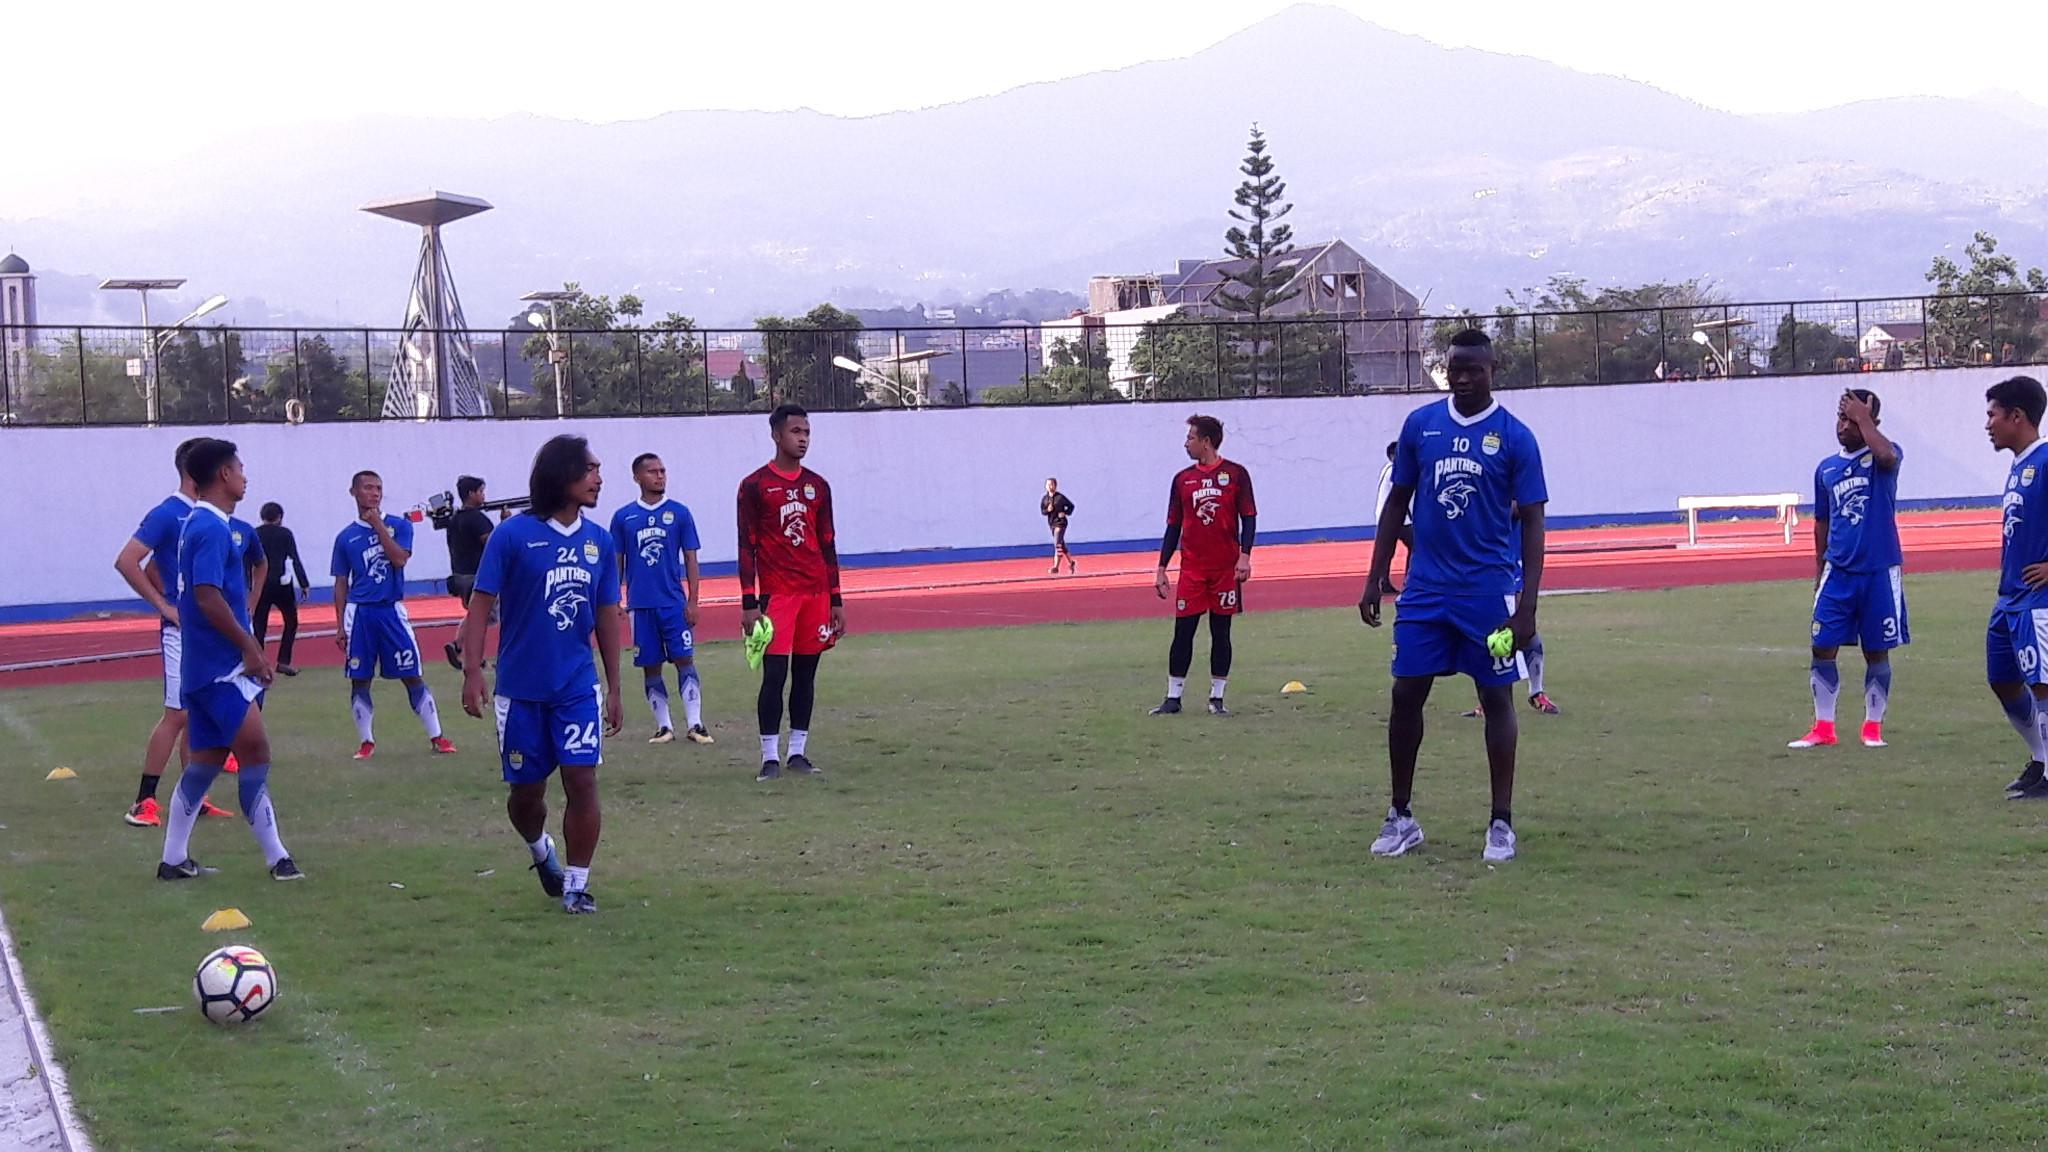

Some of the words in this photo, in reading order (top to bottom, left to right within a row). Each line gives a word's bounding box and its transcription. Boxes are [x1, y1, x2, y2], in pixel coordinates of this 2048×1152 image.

[1452, 437, 1469, 452] 10
[1434, 457, 1482, 490] PANTHER
[648, 516, 656, 526] 9
[556, 547, 579, 563] 24
[544, 566, 591, 600] PANTHER
[1218, 590, 1236, 606] 78
[1883, 617, 1897, 637] 3
[681, 629, 692, 646] 9
[394, 649, 415, 666] 12
[2018, 645, 2038, 673] 80
[564, 721, 599, 750] 24
